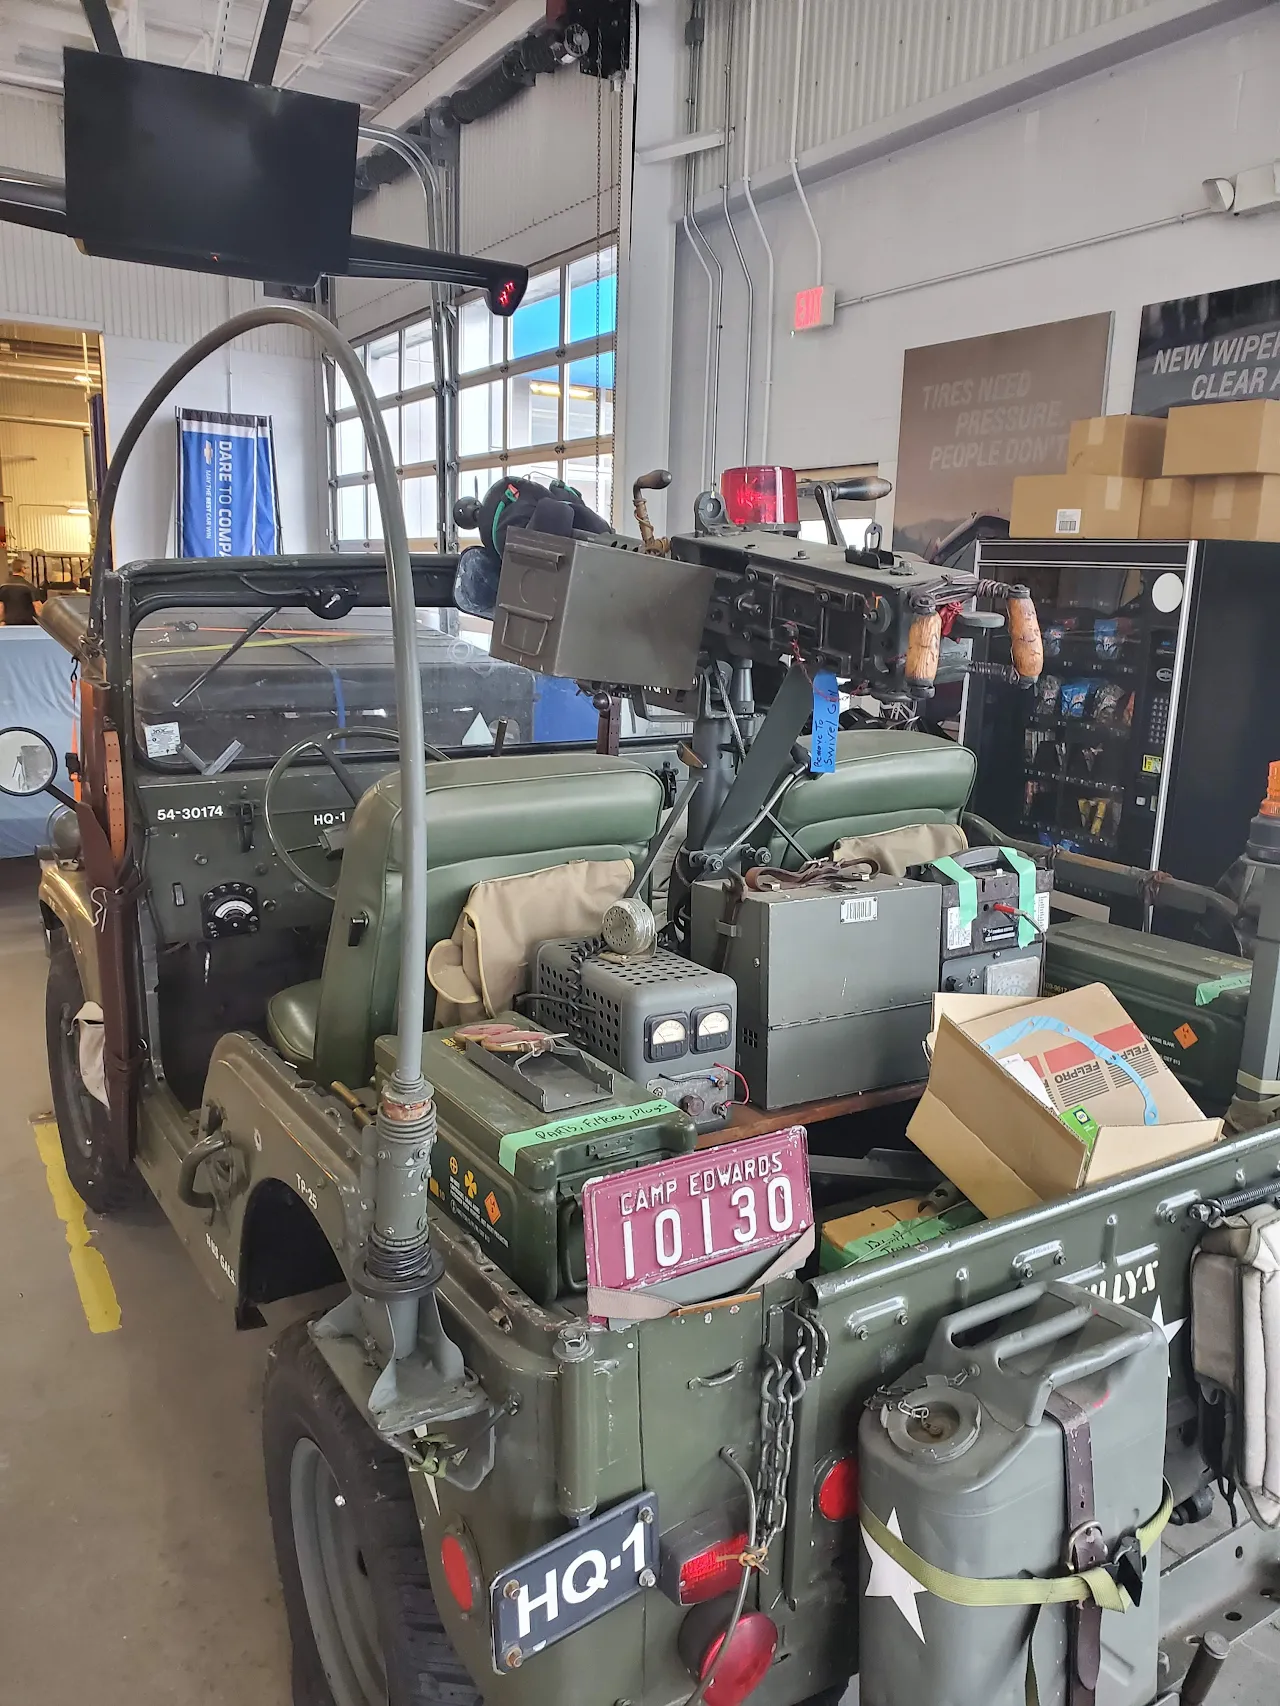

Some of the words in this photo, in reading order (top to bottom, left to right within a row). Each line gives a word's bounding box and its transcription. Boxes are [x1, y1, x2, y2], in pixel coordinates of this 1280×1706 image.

[1152, 342, 1208, 375] NEW
[922, 378, 974, 411] TIRES
[978, 369, 1031, 403] NEED
[1191, 366, 1267, 400] CLEAR
[219, 440, 232, 482] DARE
[929, 440, 1003, 471] PEOPLE
[218, 486, 232, 505] TO
[824, 719, 838, 766] Swivel
[157, 804, 223, 821] 54-30174
[313, 811, 346, 826] HQ-1
[1054, 1060, 1101, 1084] FEL-PRO
[295, 1172, 318, 1210] TP-25
[620, 1180, 678, 1216] CAMP
[688, 1151, 783, 1196] EDWARDS
[622, 1175, 794, 1280] 10130
[516, 1521, 646, 1639] HQ-1
